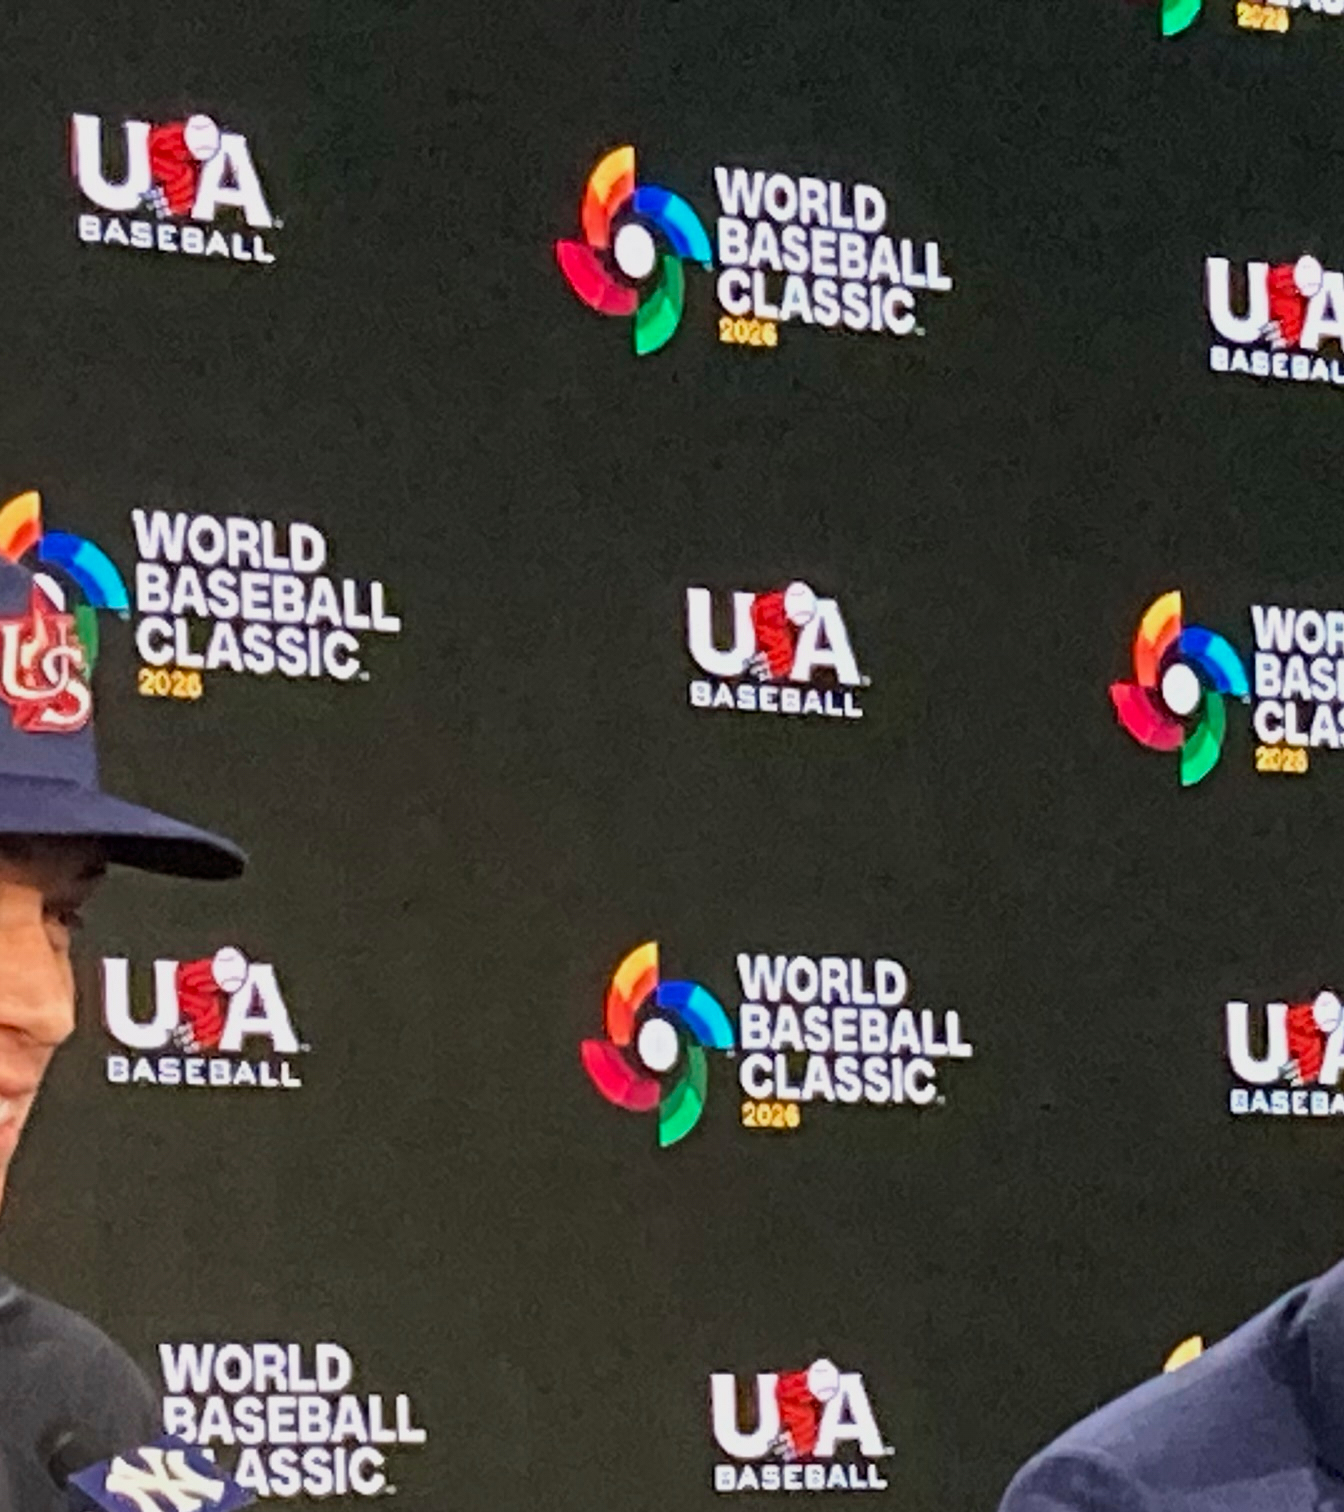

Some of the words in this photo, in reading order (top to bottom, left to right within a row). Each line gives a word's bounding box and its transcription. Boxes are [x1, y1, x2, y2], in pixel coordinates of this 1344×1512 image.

[714, 167, 886, 232] WORLD
[78, 214, 275, 264] BASEBALL
[717, 217, 952, 291] BASEBALL
[717, 268, 916, 335] CLASSIC
[718, 317, 778, 347] 2026
[132, 509, 326, 573] WORLD
[136, 562, 401, 632] BASEBALL
[135, 617, 360, 680] CLASSIC
[138, 667, 203, 699] 2026
[690, 680, 863, 719] BASEBALL
[737, 953, 906, 1007] WORLD
[740, 1003, 973, 1057] BASEBALL
[107, 1056, 302, 1087] BASEBALL
[740, 1052, 937, 1105] CLASSIC
[741, 1100, 800, 1128] 2026
[159, 1343, 353, 1393] WORLD
[163, 1394, 427, 1445] BASEBALL
[714, 1464, 889, 1491] BASEBALL
